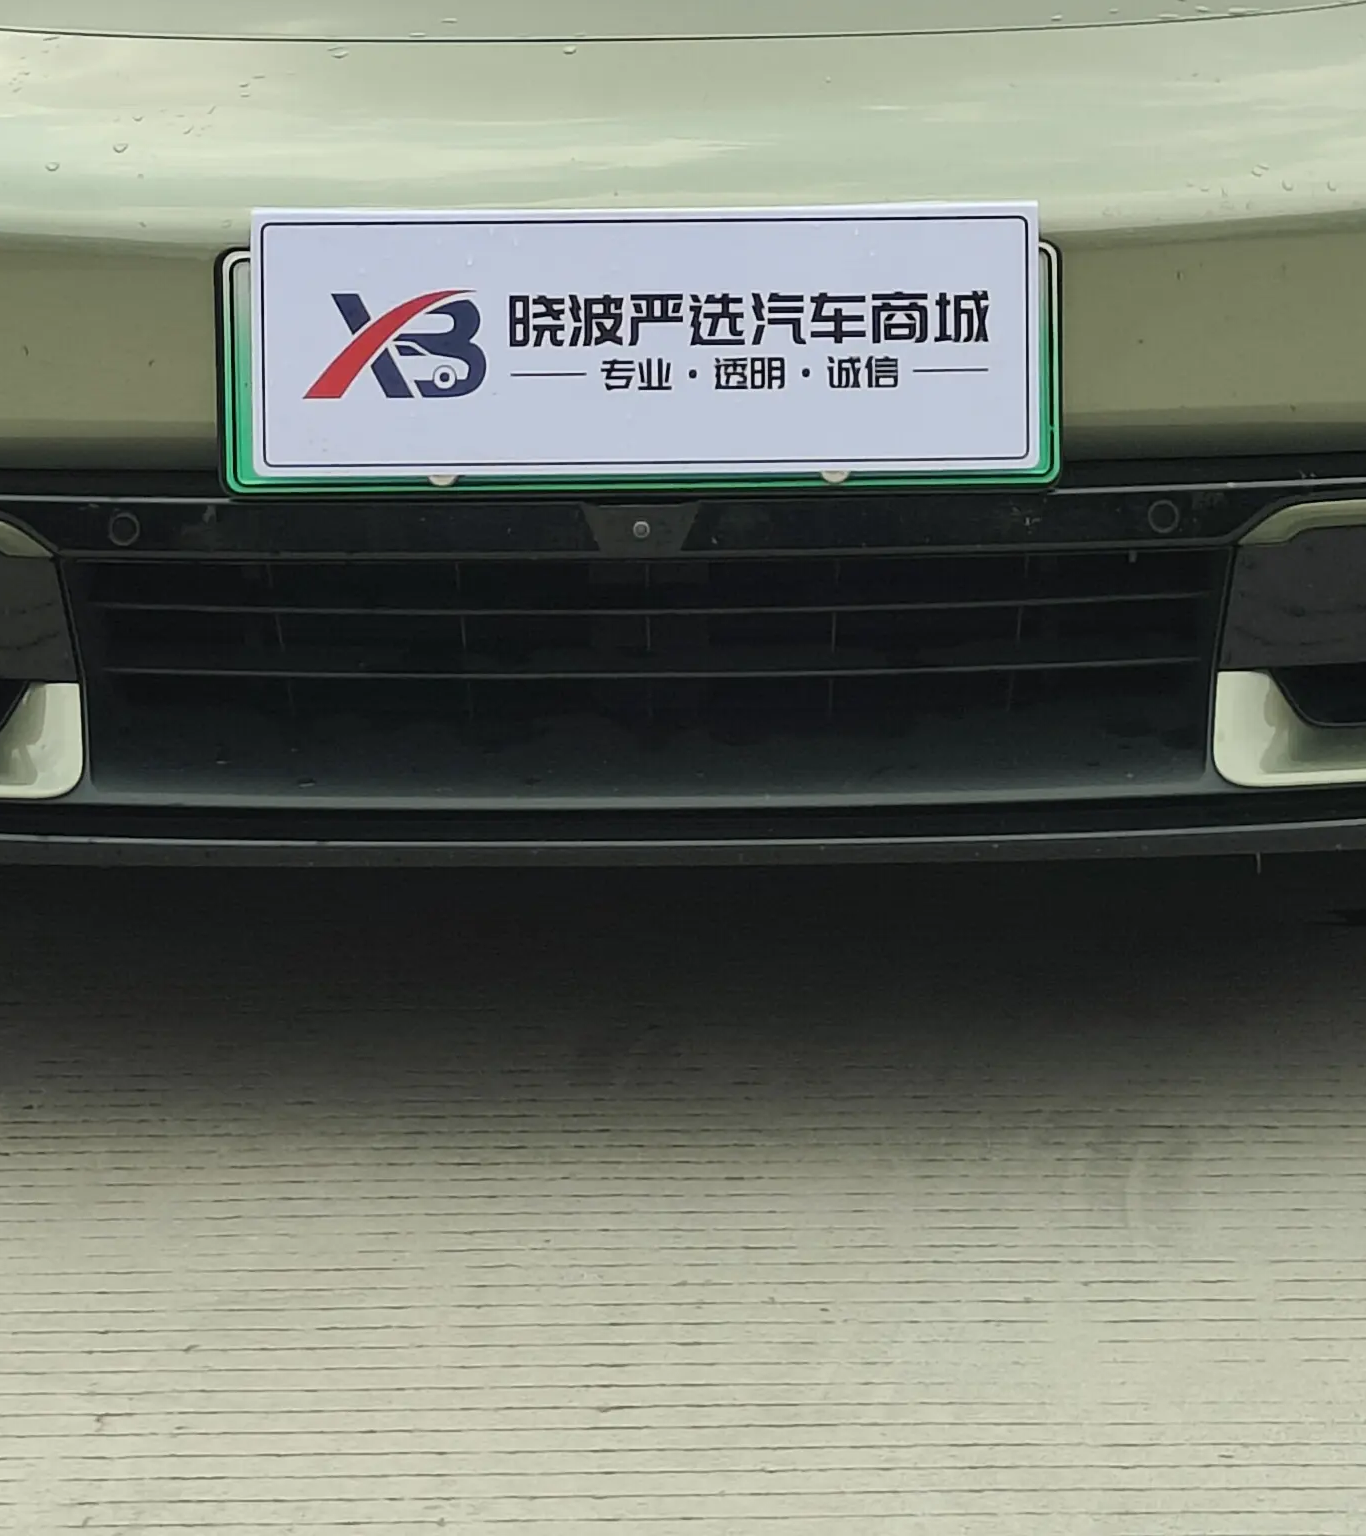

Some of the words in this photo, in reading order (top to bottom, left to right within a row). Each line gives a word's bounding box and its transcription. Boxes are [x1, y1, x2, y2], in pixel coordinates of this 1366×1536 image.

[508, 290, 990, 348] 晓波严选汽车商城
